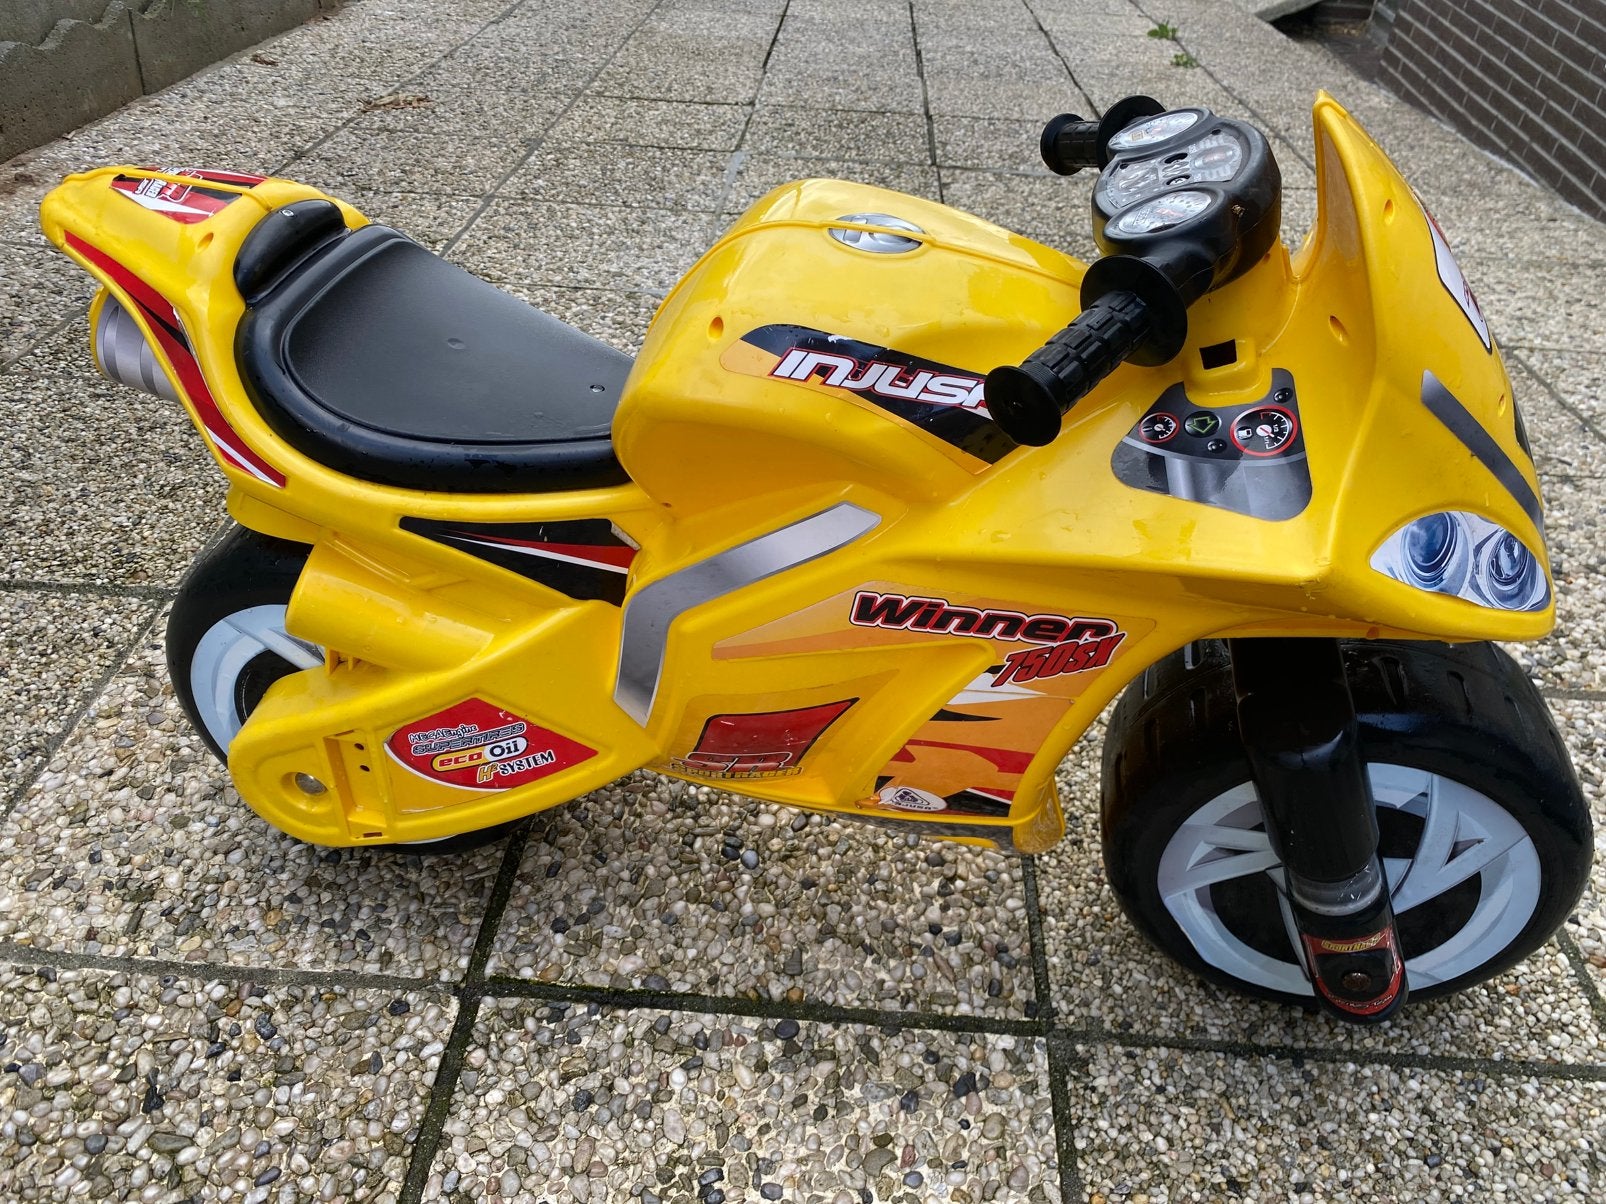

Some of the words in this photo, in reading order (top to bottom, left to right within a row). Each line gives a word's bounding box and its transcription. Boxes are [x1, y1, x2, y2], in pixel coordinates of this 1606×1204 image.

[850, 591, 1118, 644] Winner
[990, 631, 1127, 687] 750SX
[489, 739, 520, 758] Oil
[499, 750, 556, 776] SYSTEM
